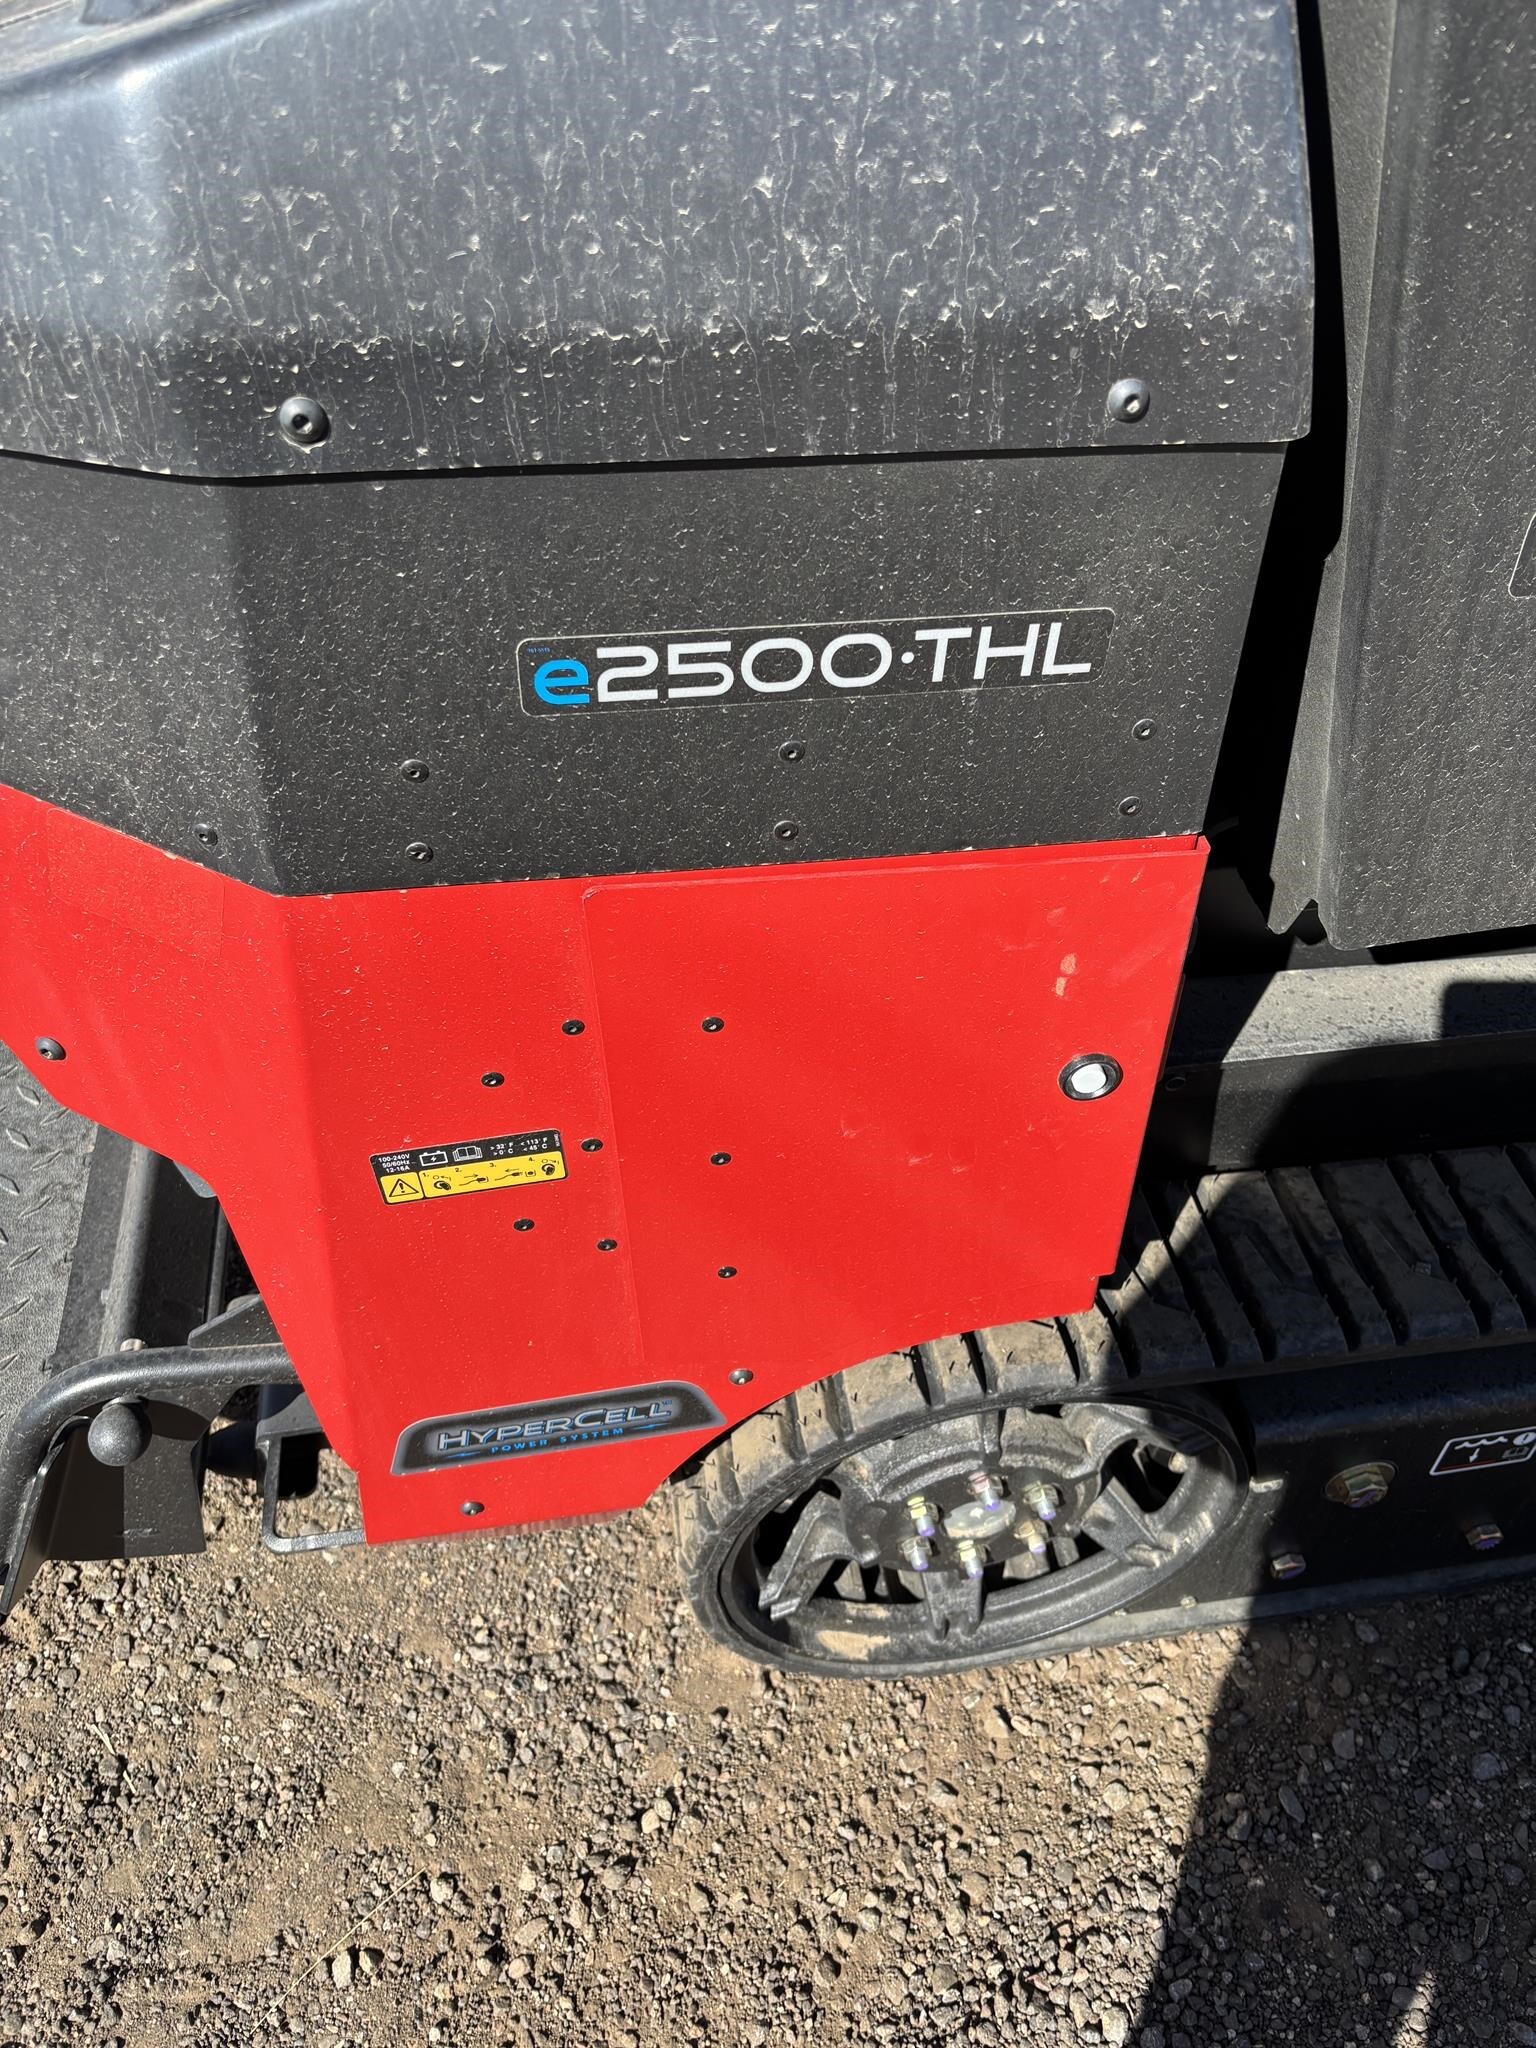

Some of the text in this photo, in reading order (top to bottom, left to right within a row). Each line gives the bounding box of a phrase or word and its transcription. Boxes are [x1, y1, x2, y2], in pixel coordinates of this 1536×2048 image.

[378, 1154, 410, 1162] 100-240V
[382, 1160, 410, 1168] 50/60Hz
[386, 1165, 410, 1173] 12-16A
[491, 1427, 624, 1454] POWER SYSTEM
